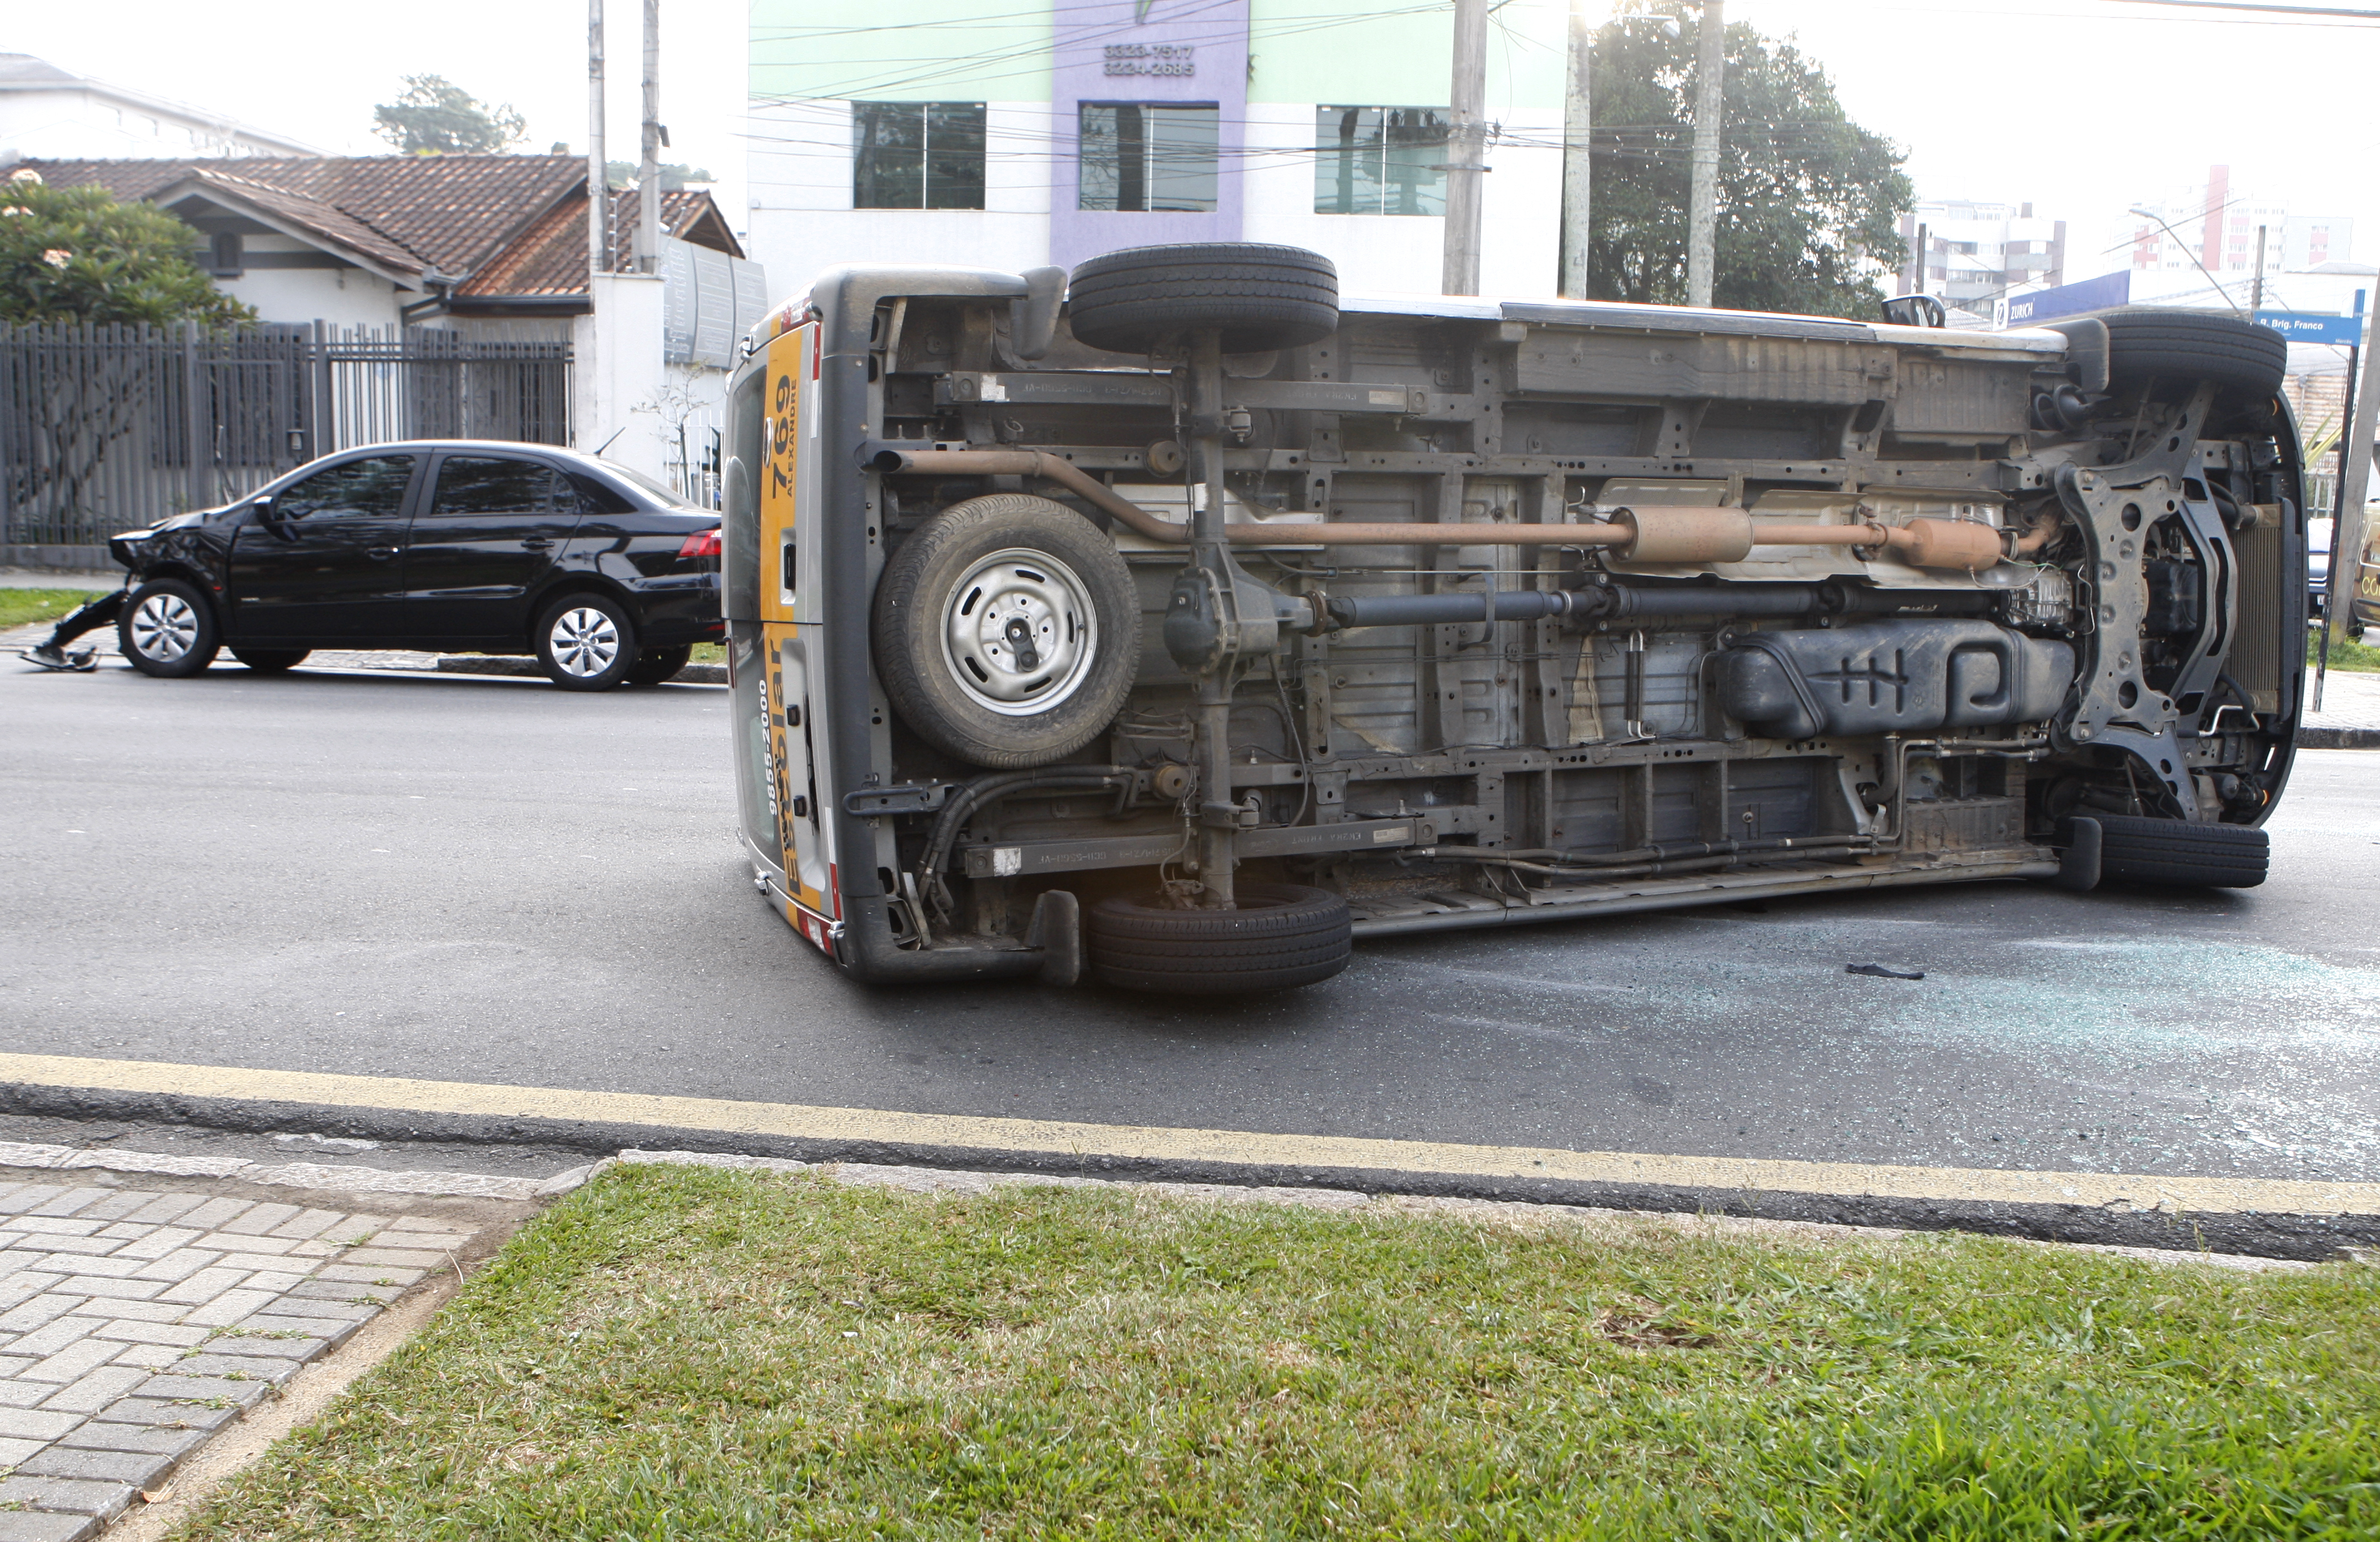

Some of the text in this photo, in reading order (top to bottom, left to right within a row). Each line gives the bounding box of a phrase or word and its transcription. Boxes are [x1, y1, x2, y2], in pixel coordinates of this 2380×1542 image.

[1104, 44, 1193, 59] 3323-7517
[1104, 63, 1195, 76] 3224-2685
[2010, 302, 2034, 320] ZURICH
[2272, 319, 2292, 330] Brig.
[2294, 320, 2323, 330] Franco
[772, 375, 790, 499] 769
[787, 378, 797, 498] ALEXANDRE
[2361, 576, 2380, 596] ca
[759, 679, 777, 816] 9855-2000
[770, 638, 802, 897] Escolar
